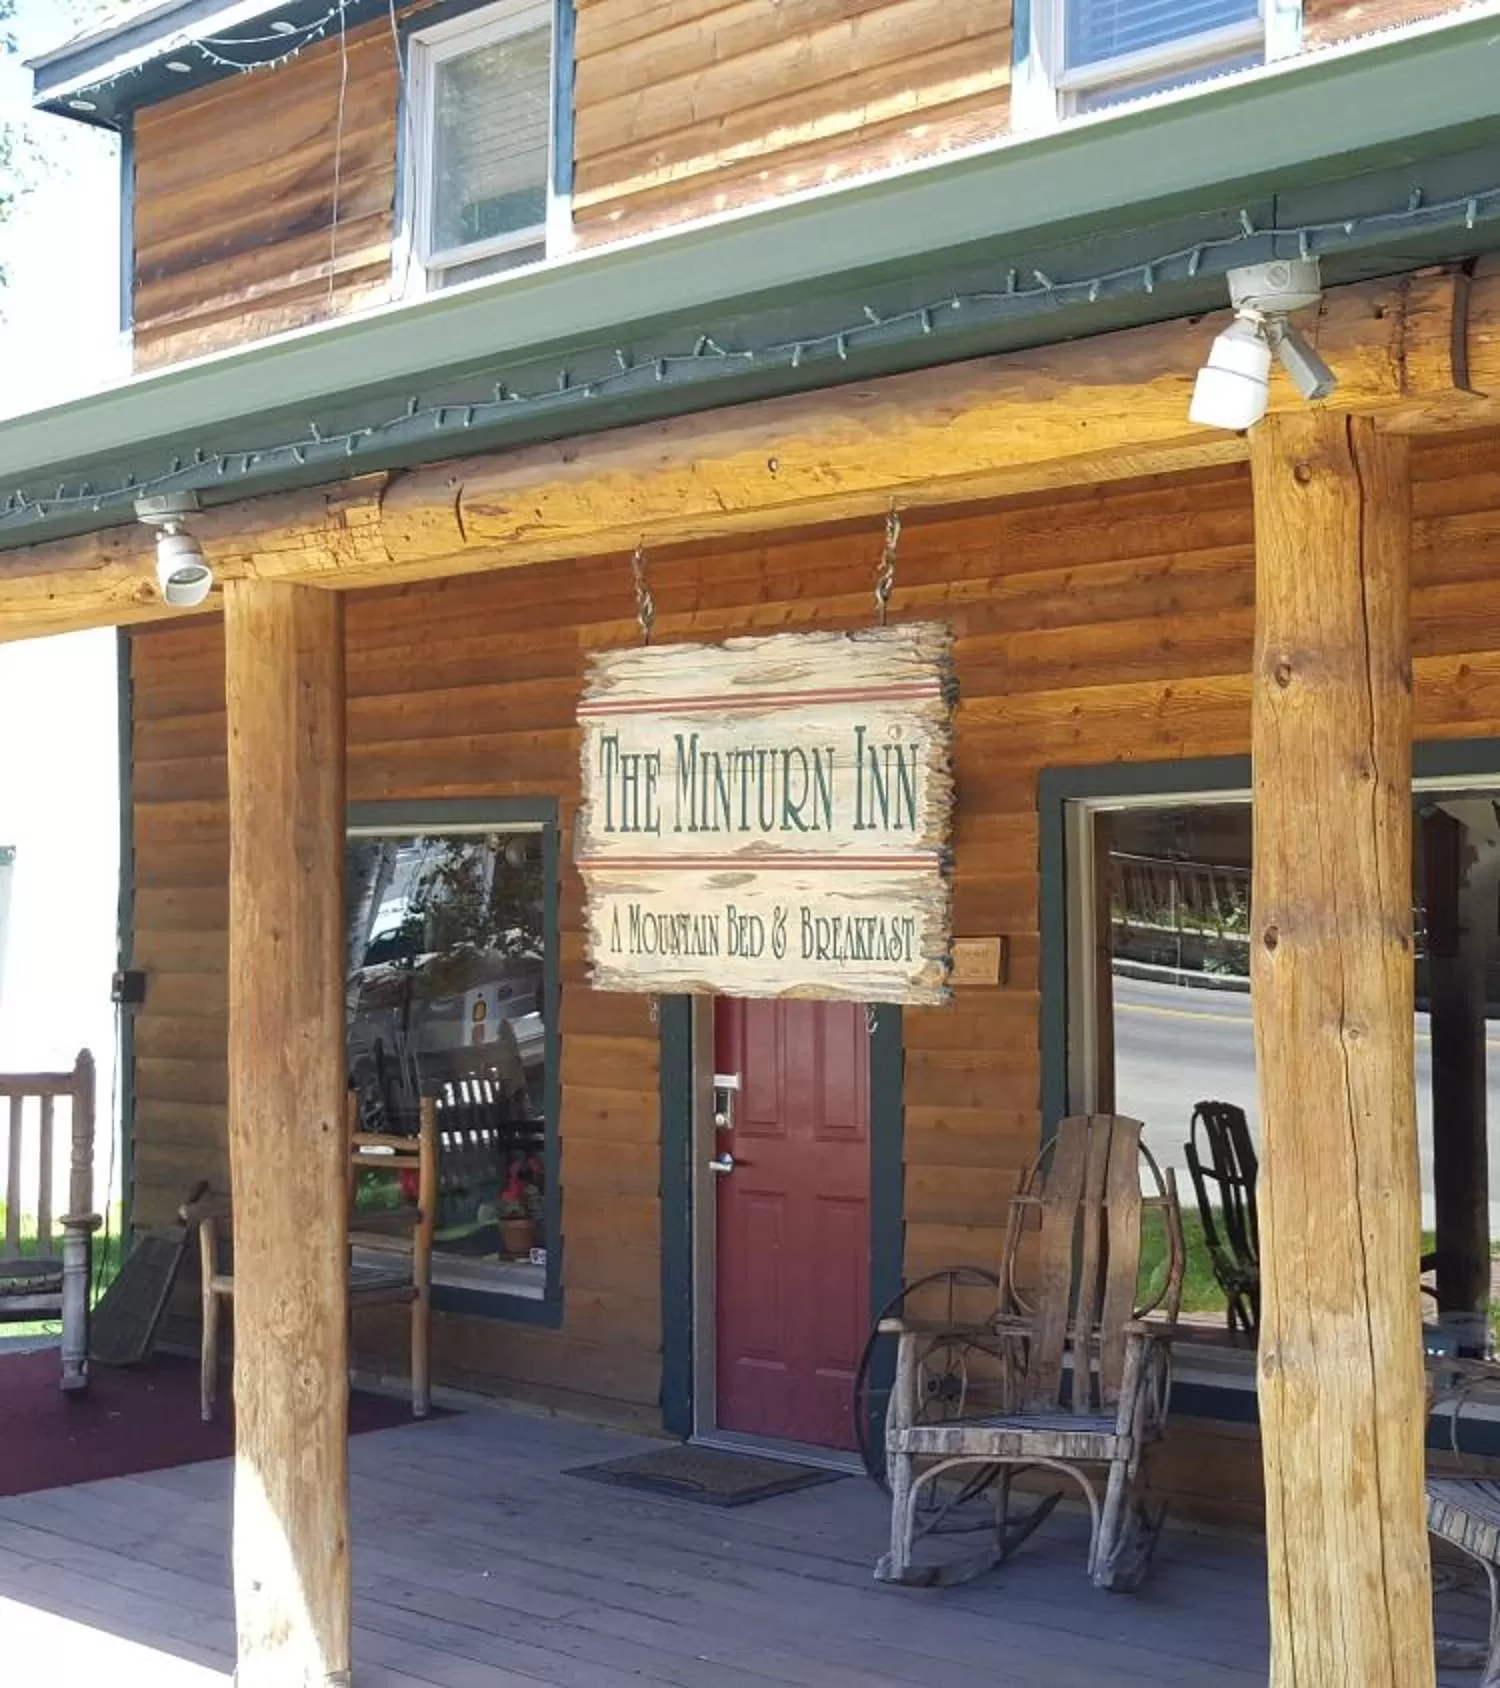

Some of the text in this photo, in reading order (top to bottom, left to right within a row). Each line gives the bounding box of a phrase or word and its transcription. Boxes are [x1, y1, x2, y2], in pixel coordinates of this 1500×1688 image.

[600, 725, 920, 837] THE MINTURN INN
[610, 903, 623, 953] A
[628, 903, 720, 957] MOUNTAIN
[726, 904, 765, 959] BED
[772, 905, 789, 959] &
[800, 906, 915, 966] BREAKFAST
